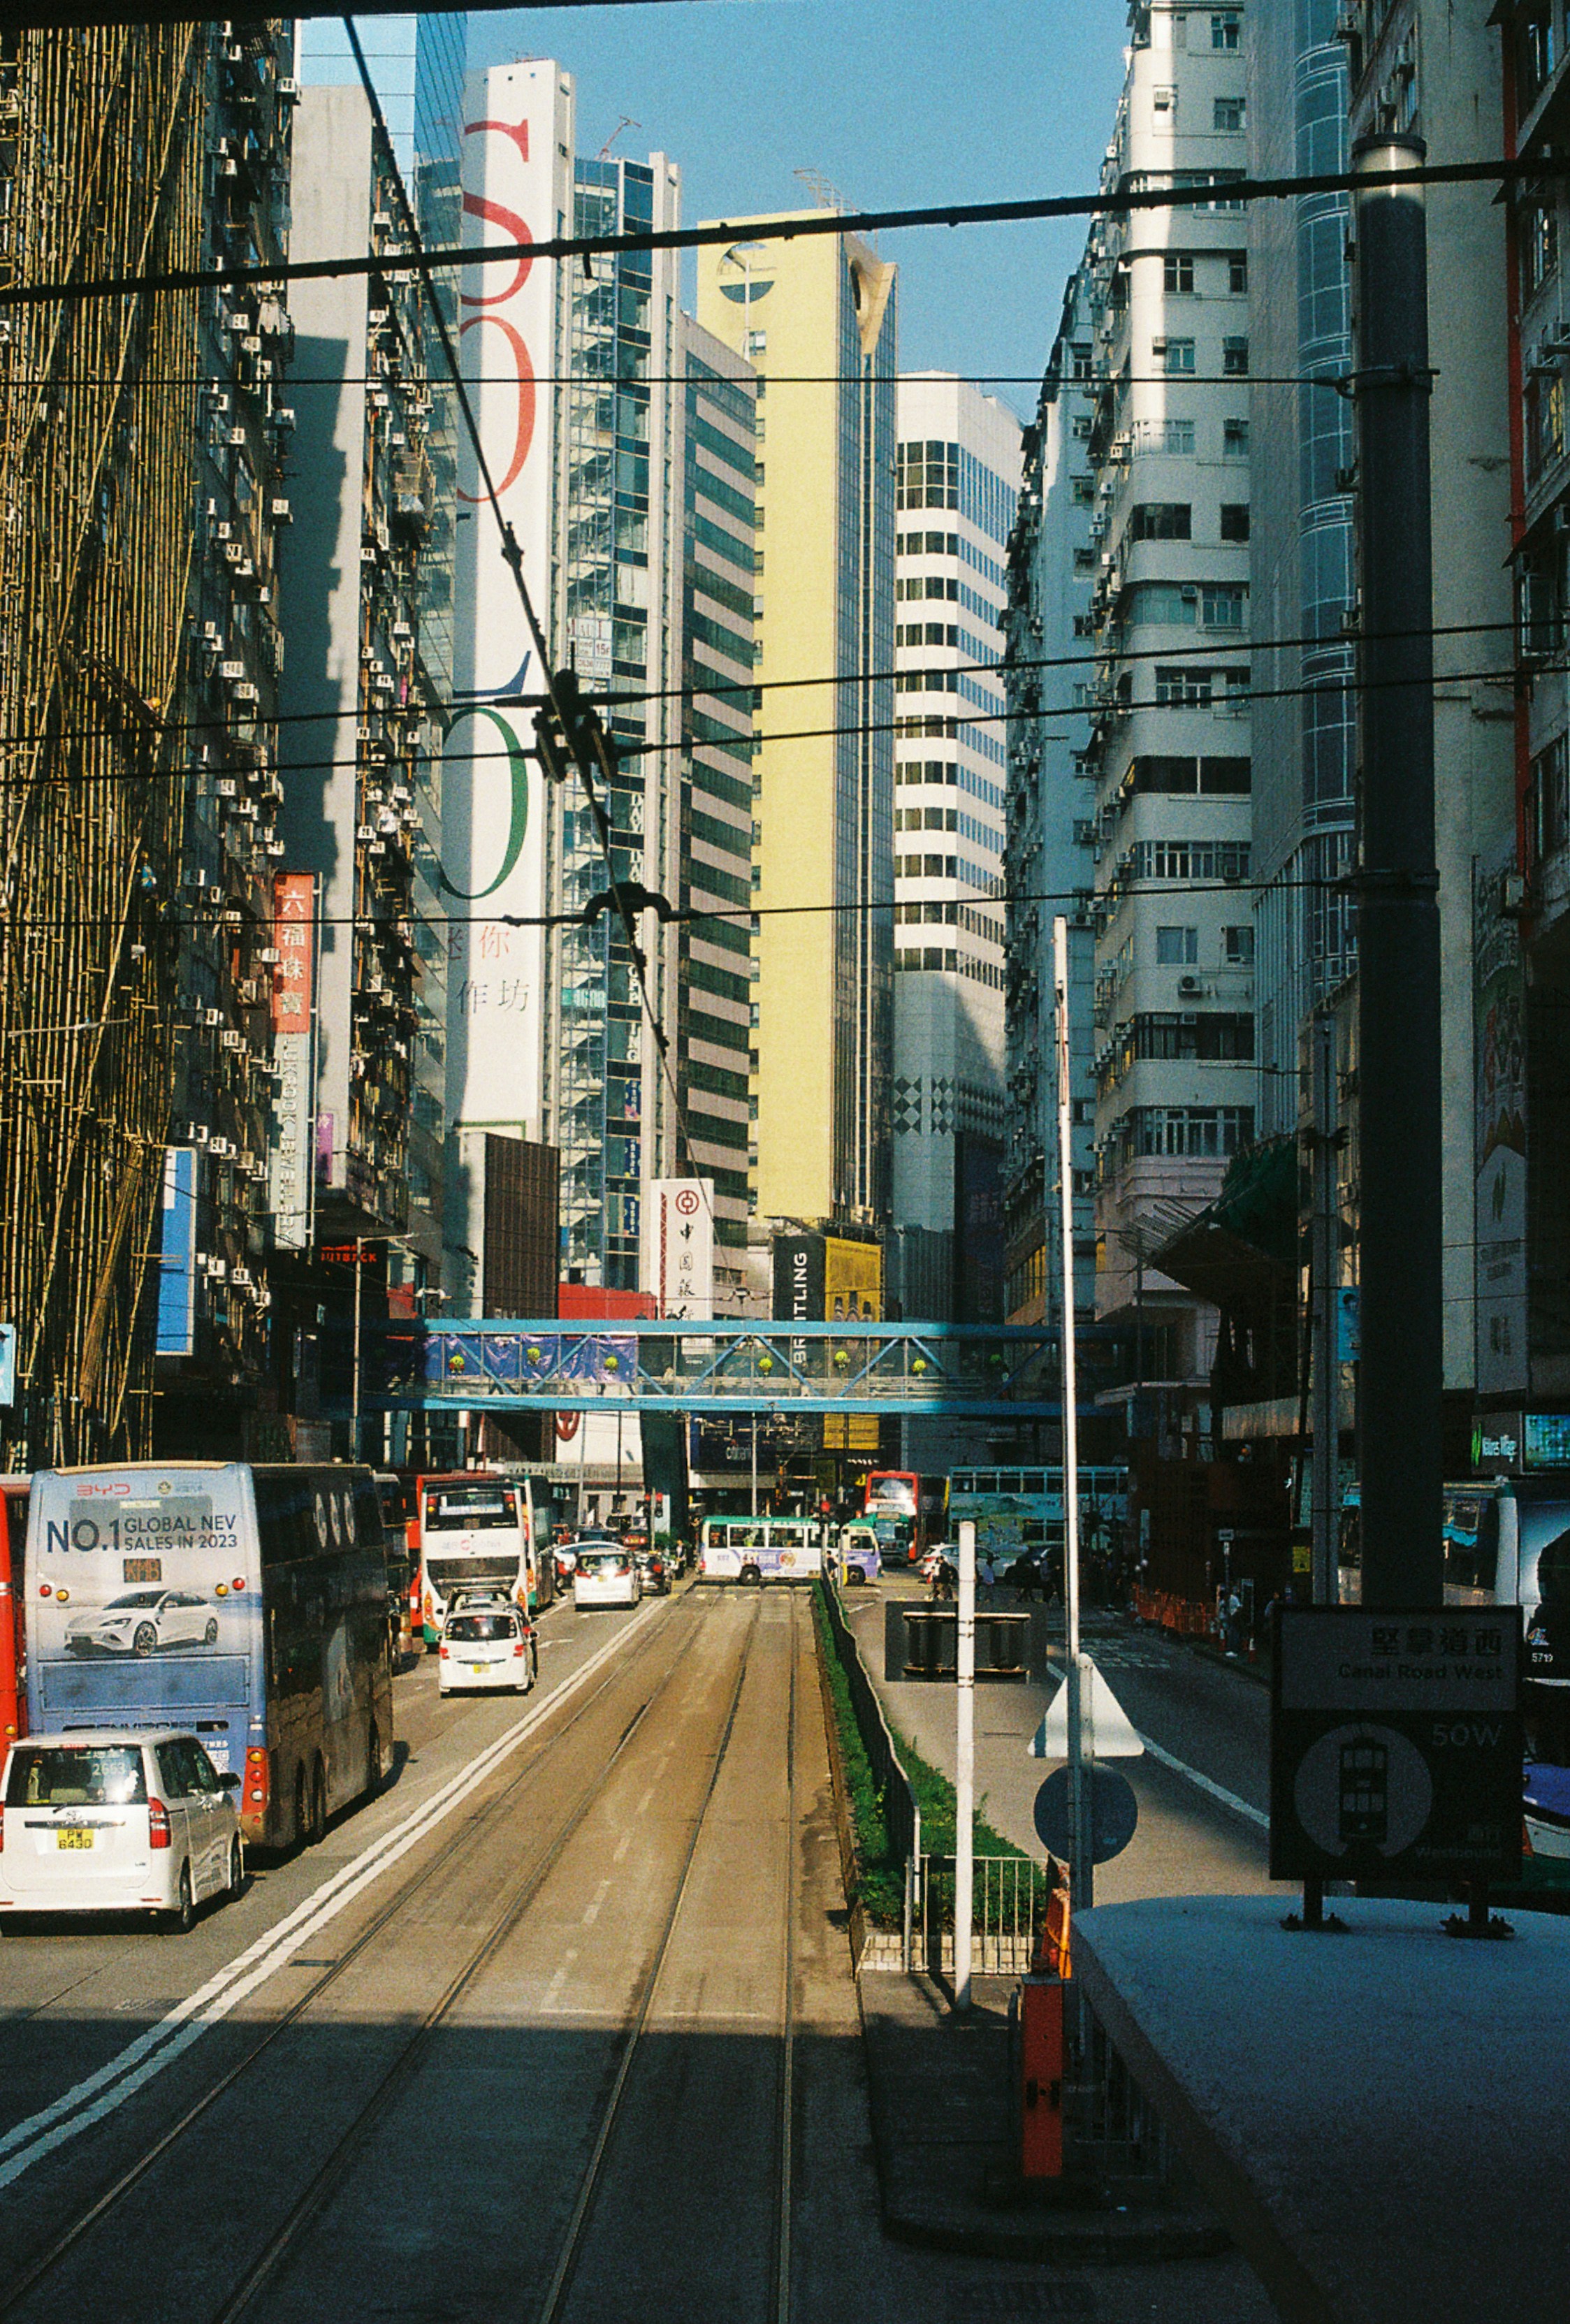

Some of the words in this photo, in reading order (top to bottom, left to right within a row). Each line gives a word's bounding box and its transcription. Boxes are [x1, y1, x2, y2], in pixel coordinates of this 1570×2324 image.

[281, 890, 305, 1016] 六福珠寶
[456, 979, 530, 1013] 作坊
[793, 1252, 808, 1364] BRITLING
[77, 1483, 131, 1496] BYD
[47, 1518, 120, 1553] NO.1
[124, 1516, 196, 1534] GLOBAL
[201, 1514, 236, 1531] NEV
[125, 1536, 173, 1551] SALES
[178, 1535, 194, 1549] IN
[199, 1534, 238, 1548] 2023
[1371, 1627, 1502, 1656] 堅拿道西
[1338, 1663, 1390, 1678] Canal
[1398, 1663, 1447, 1678] Road
[1454, 1663, 1503, 1678] West
[1432, 1723, 1502, 1747] 50W
